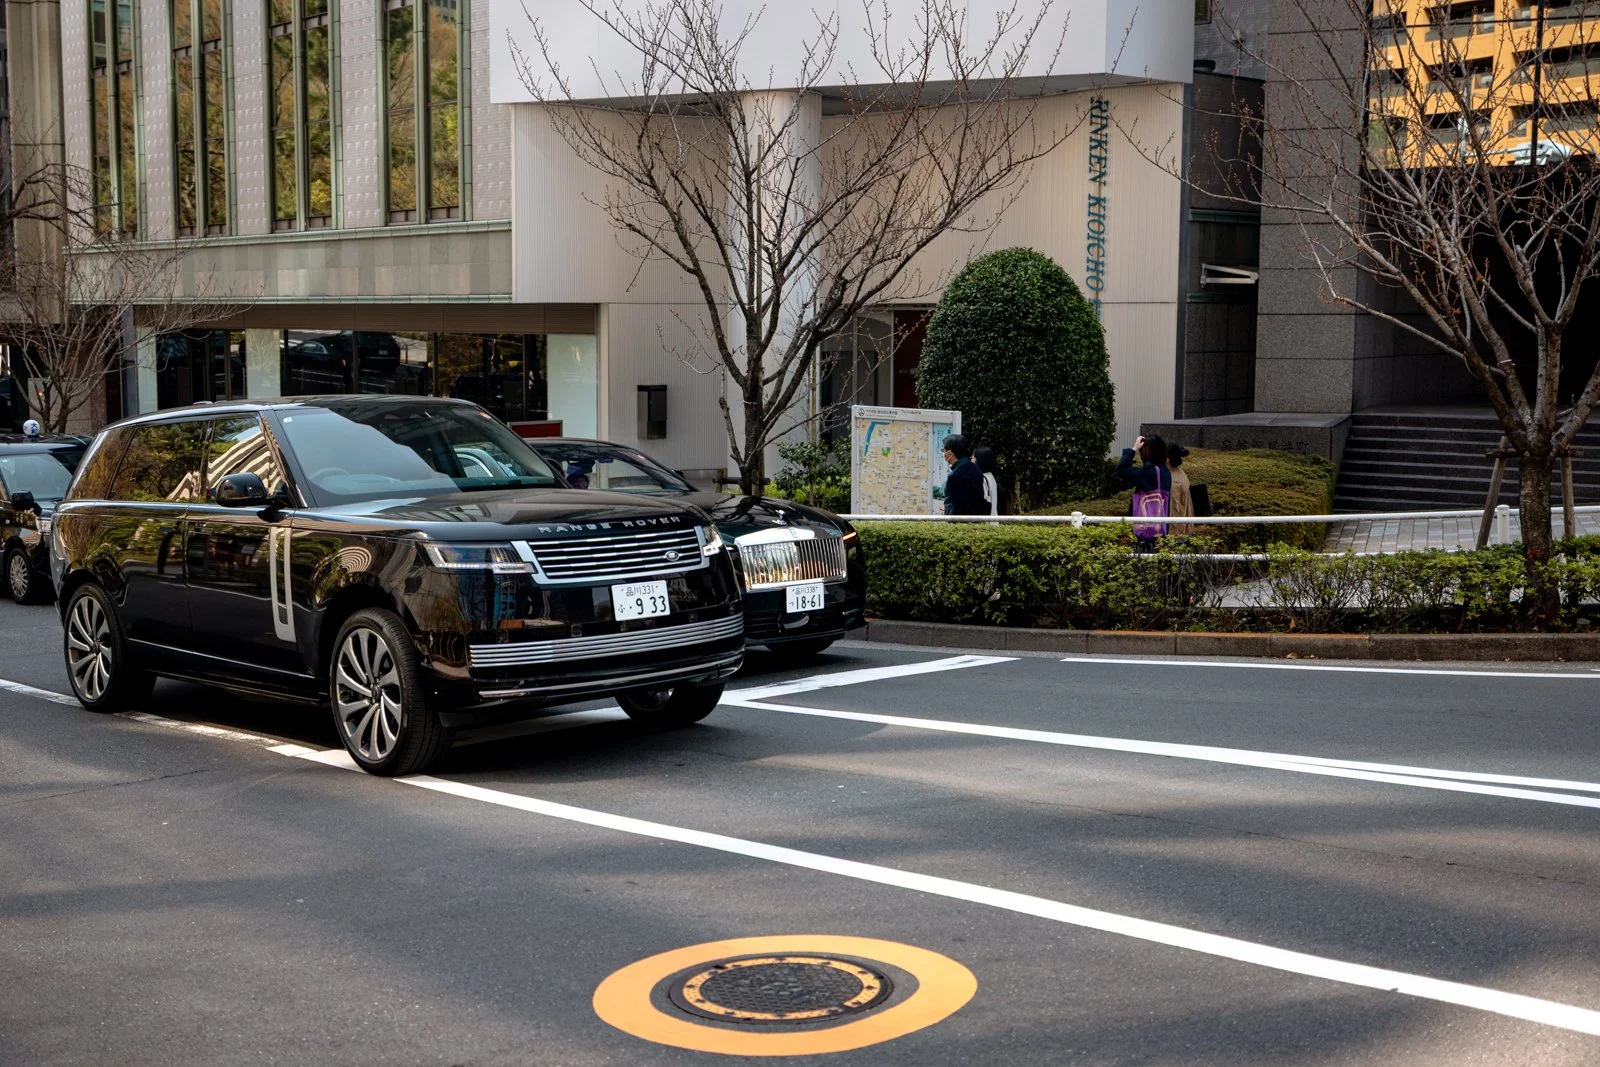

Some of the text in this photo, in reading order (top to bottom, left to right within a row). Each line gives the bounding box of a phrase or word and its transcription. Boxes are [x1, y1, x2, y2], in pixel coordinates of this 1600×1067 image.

[1089, 96, 1109, 187] RINKEN
[1086, 193, 1106, 292] KIOICHO
[538, 516, 681, 533] RANGE ROVER
[796, 593, 821, 610] 18-61
